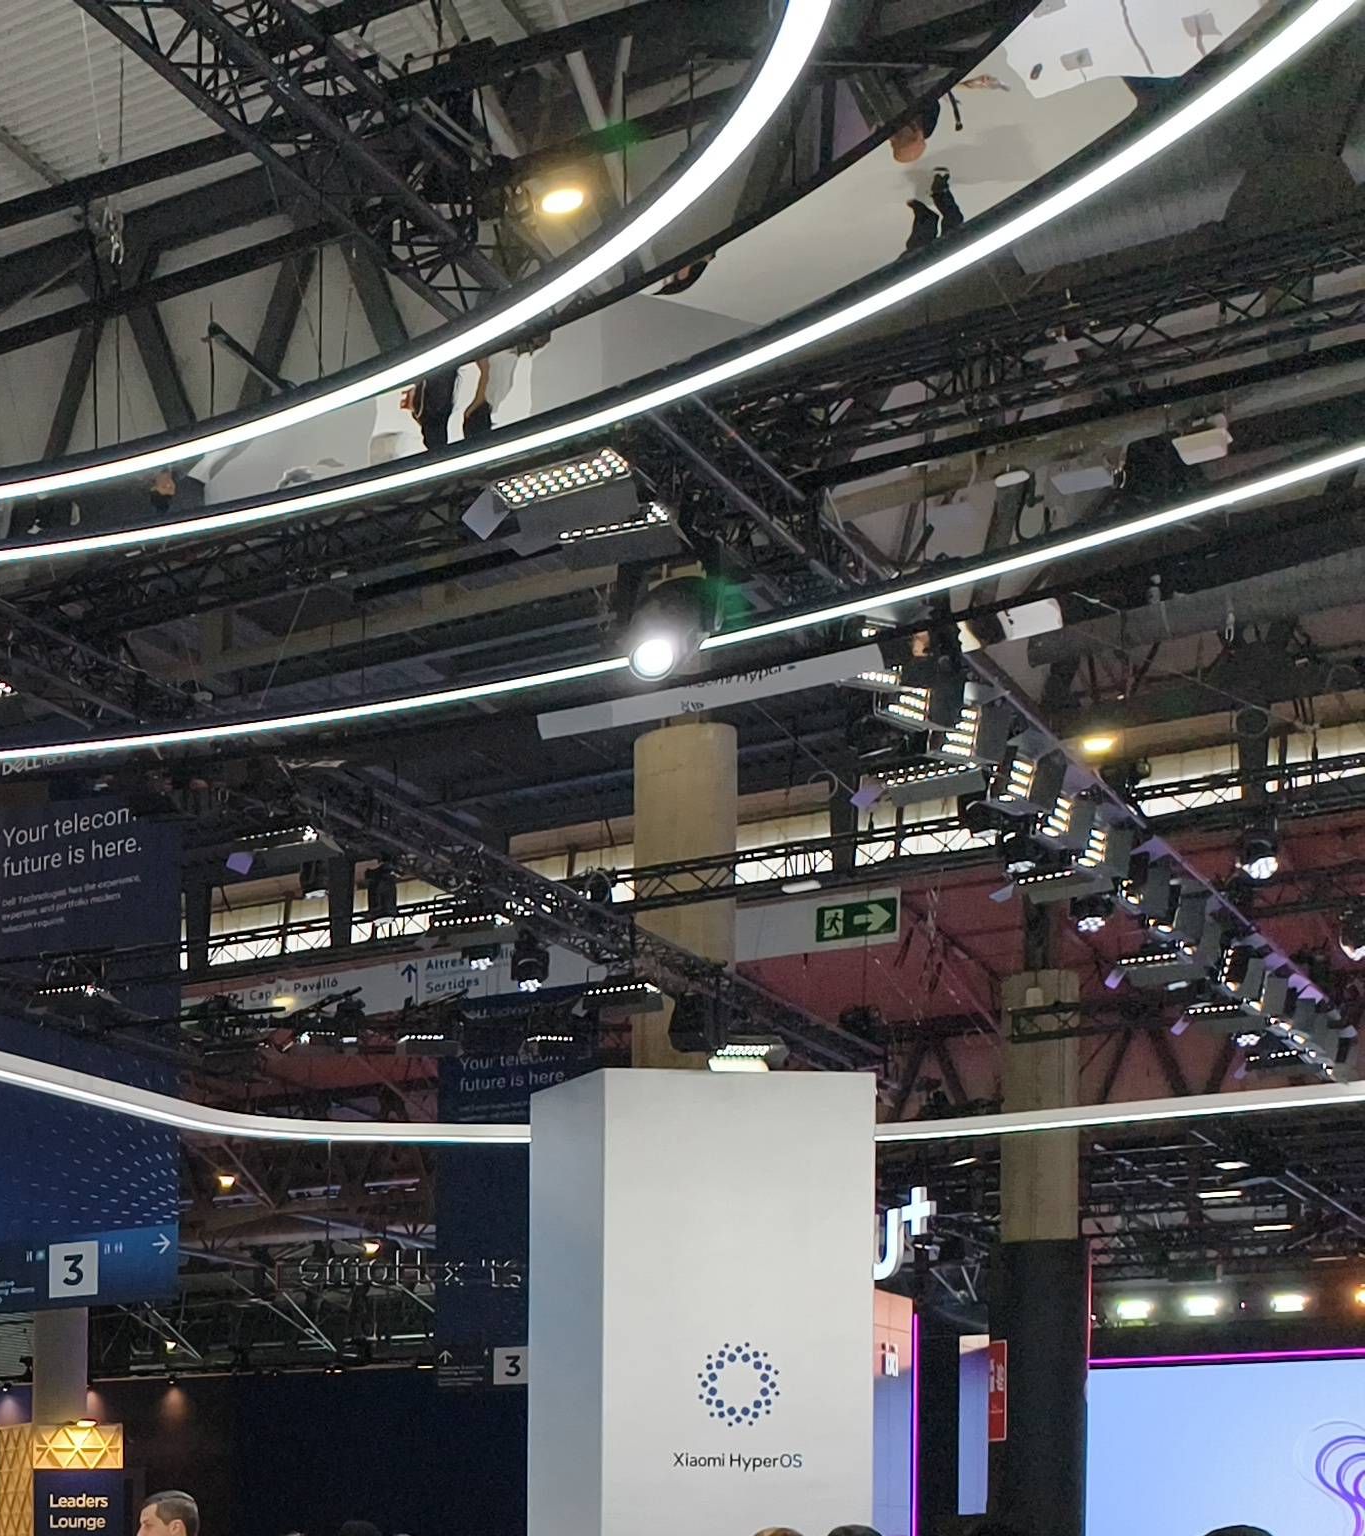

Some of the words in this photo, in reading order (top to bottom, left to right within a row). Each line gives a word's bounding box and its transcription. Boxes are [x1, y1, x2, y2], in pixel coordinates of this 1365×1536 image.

[2, 822, 49, 849] Your
[3, 852, 62, 878] future
[68, 845, 85, 866] is
[91, 836, 142, 861] here.
[459, 1075, 506, 1093] future
[510, 1073, 524, 1087] is
[62, 1254, 84, 1286] 3
[504, 1355, 522, 1377] 3
[673, 1452, 725, 1467] Xiaomi
[729, 1452, 803, 1472] HyperOS
[49, 1492, 109, 1508] Leaders
[49, 1514, 106, 1531] Lounge
